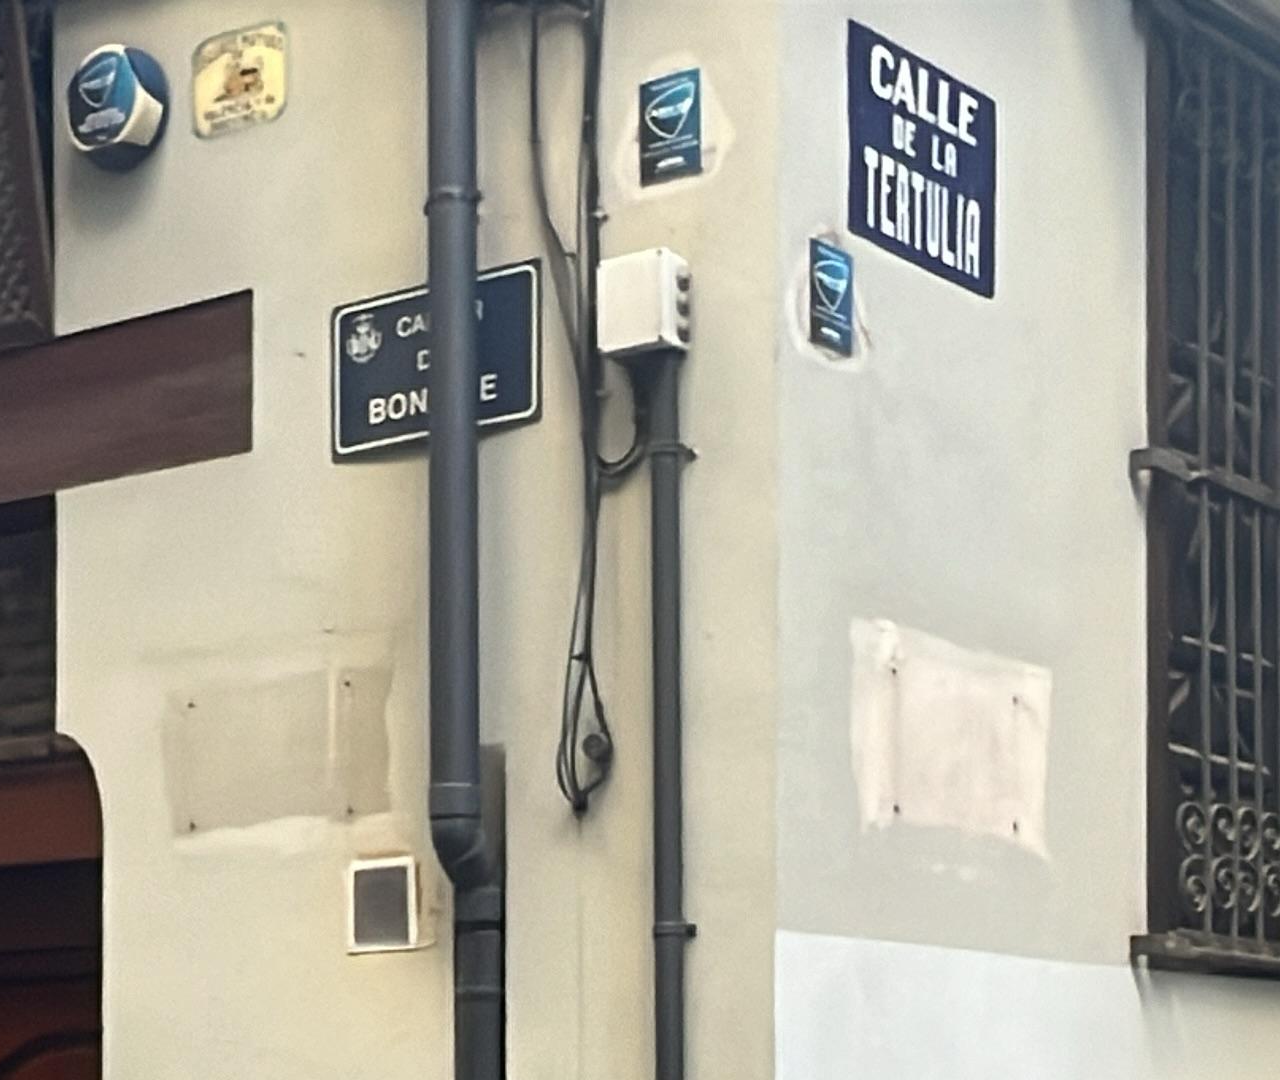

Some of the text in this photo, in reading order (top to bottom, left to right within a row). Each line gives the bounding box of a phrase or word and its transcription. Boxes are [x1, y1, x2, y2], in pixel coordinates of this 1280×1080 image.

[870, 44, 978, 147] CALLE
[892, 112, 958, 178] DE LA
[863, 145, 982, 280] TERTULIA
[368, 373, 498, 425] BONE
